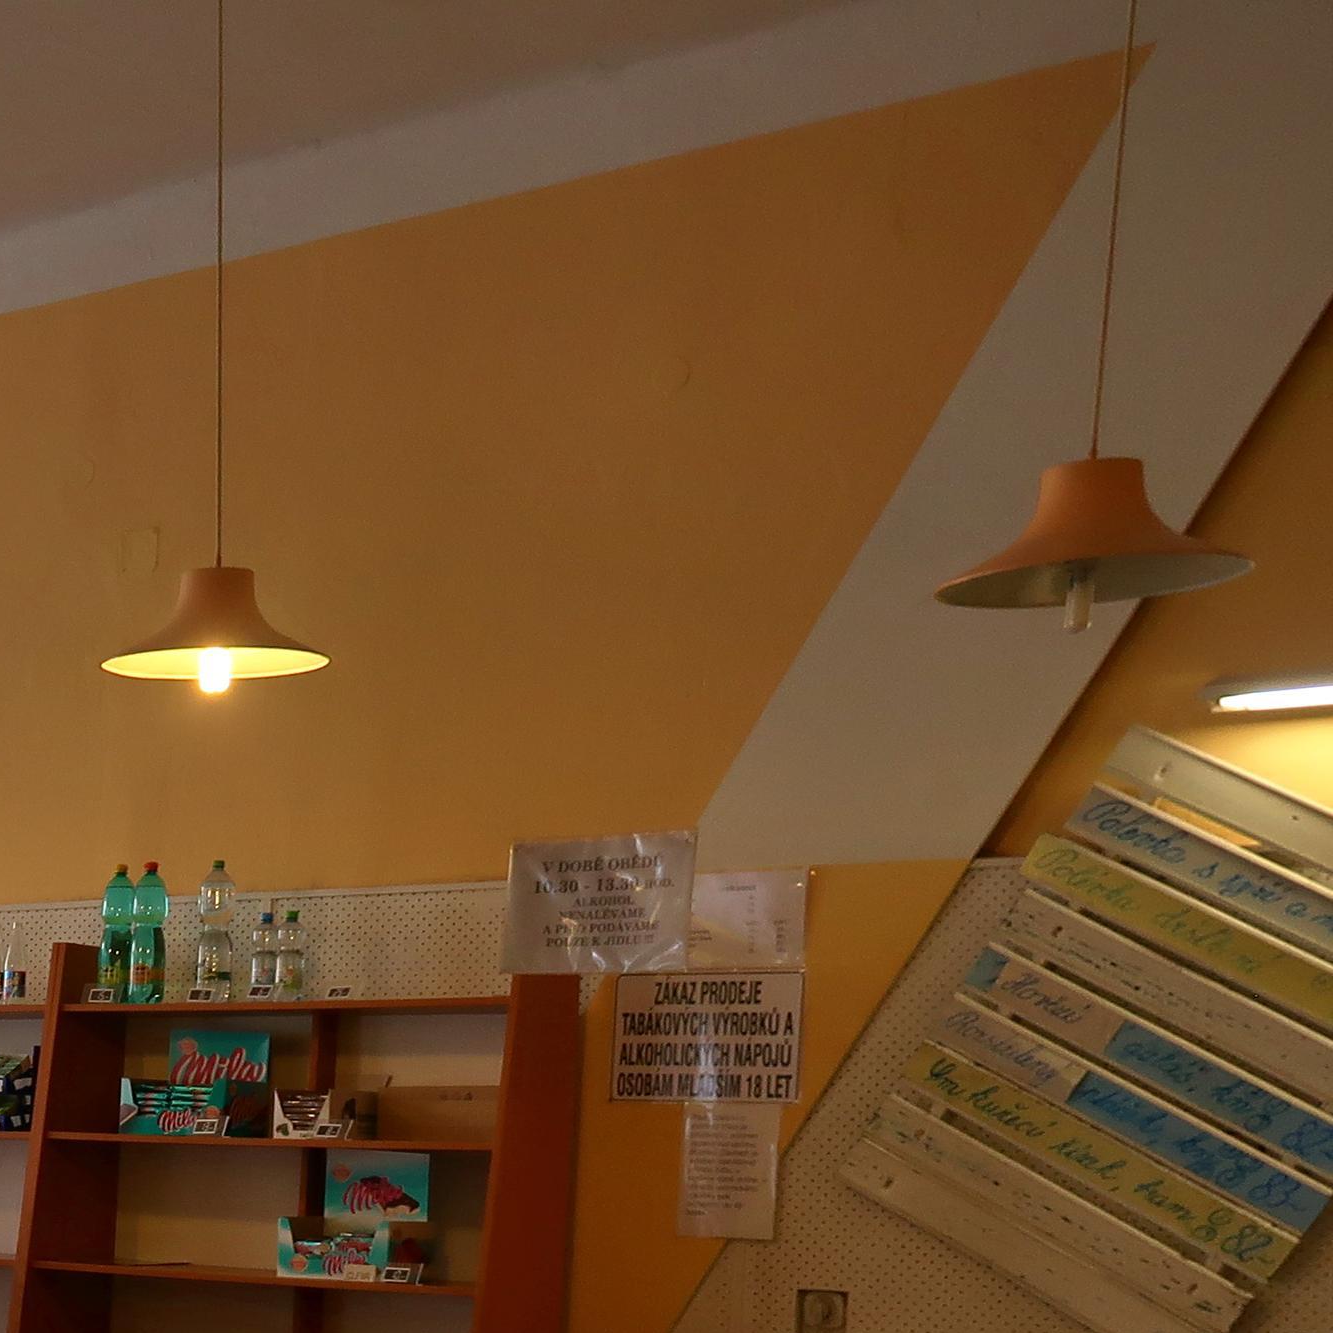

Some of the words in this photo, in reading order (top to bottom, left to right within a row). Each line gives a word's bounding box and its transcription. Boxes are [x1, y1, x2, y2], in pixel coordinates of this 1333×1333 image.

[541, 861, 555, 873] V
[557, 856, 604, 873] DOBĚ
[534, 879, 579, 895] 10.30
[596, 876, 640, 892] 13.30
[572, 894, 635, 908] ALKOHOL
[542, 925, 551, 936] A
[653, 976, 697, 1005] ZÁKAZ
[699, 980, 764, 1005] PRODEJE
[622, 1007, 709, 1036] TABÁKOVÝCH
[712, 1006, 781, 1036] VÝROBKŮ
[783, 1012, 795, 1036] A
[619, 1039, 730, 1067] ALKOHOLICKÝCH
[733, 1036, 793, 1067] NÁPOJŮ
[616, 1068, 673, 1097] OSOBÁM
[677, 1068, 742, 1098] MLADŠÍM
[745, 1075, 763, 1098] 18
[766, 1075, 793, 1099] LET
